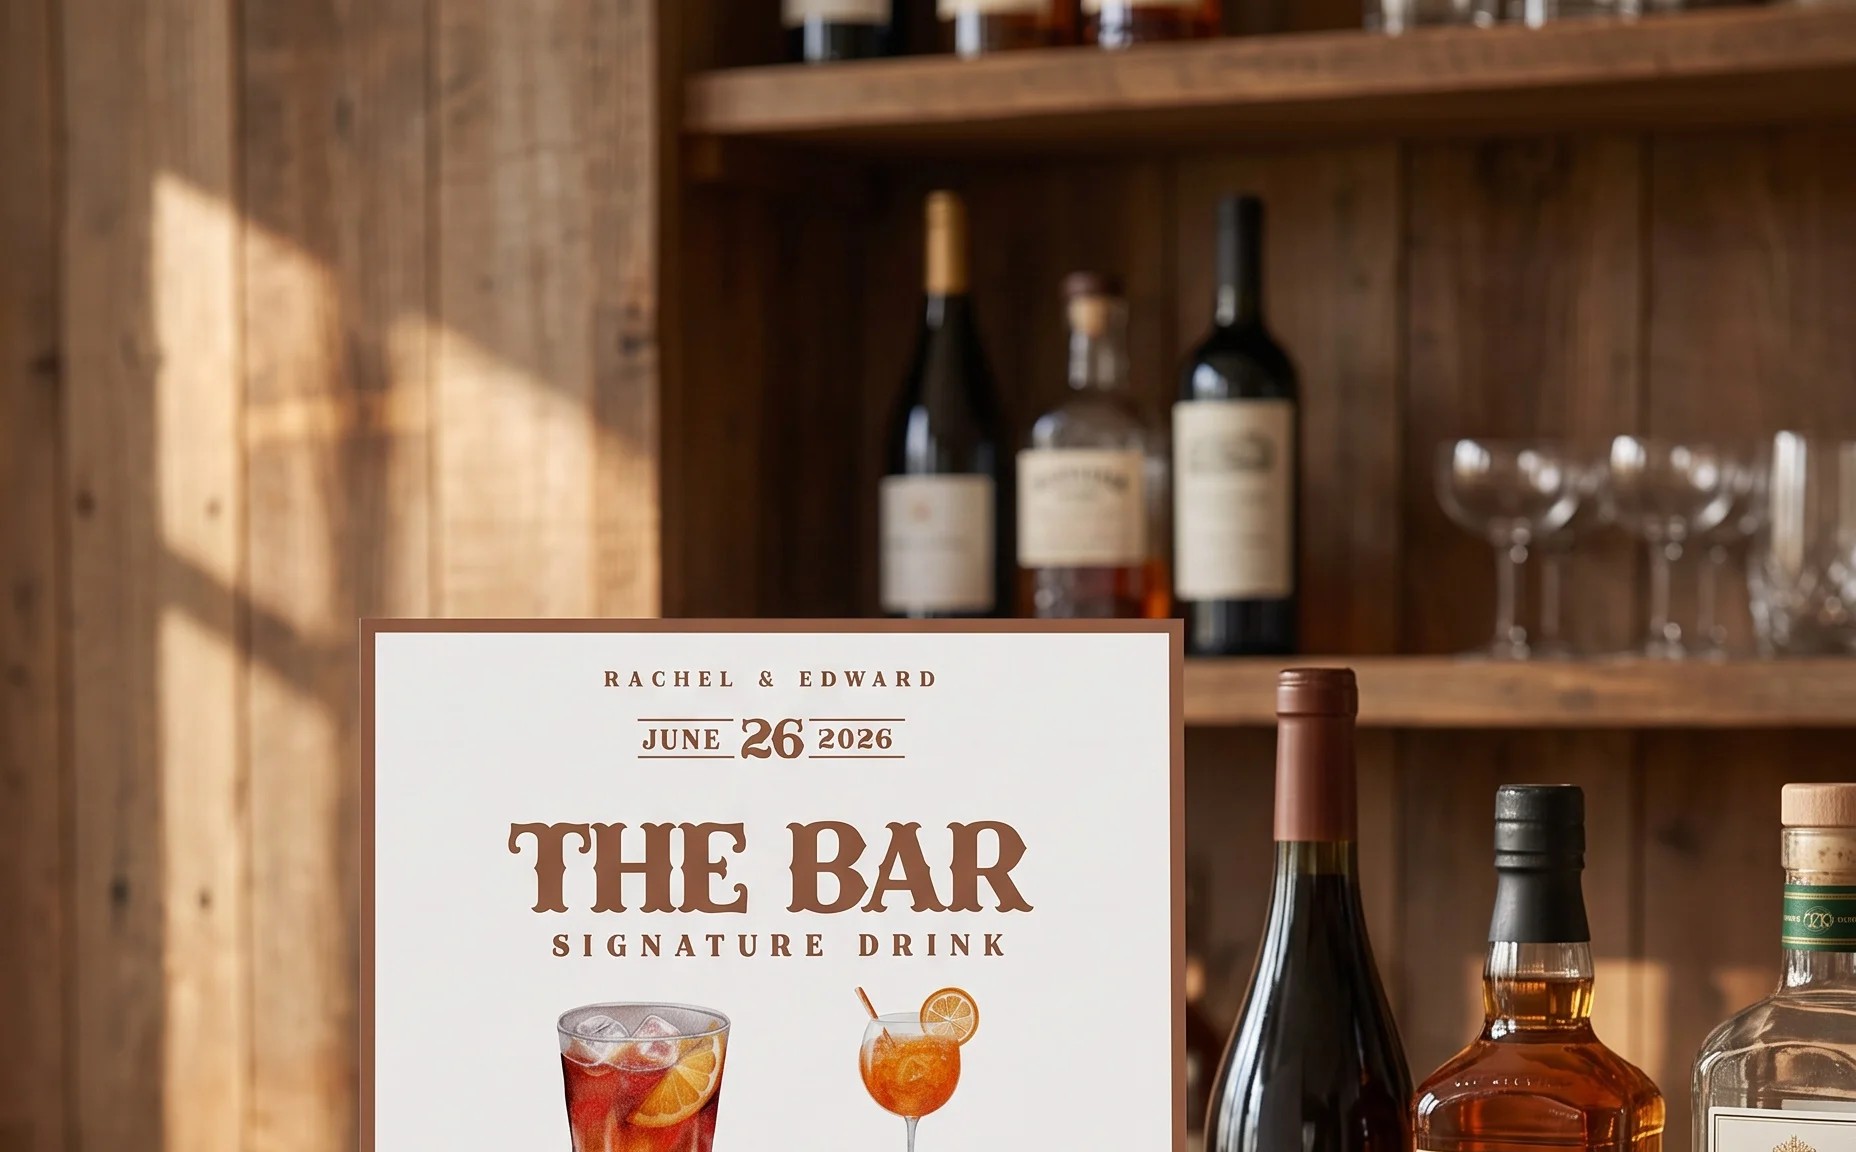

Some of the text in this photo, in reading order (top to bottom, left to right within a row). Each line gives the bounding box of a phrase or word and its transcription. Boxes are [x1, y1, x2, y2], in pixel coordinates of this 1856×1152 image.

[604, 670, 935, 688] RACHEL & EDWARD
[642, 717, 893, 760] JUNE 26 2026
[507, 820, 1035, 915] THE BAR
[552, 933, 1005, 958] SIGNATURE DRINK
